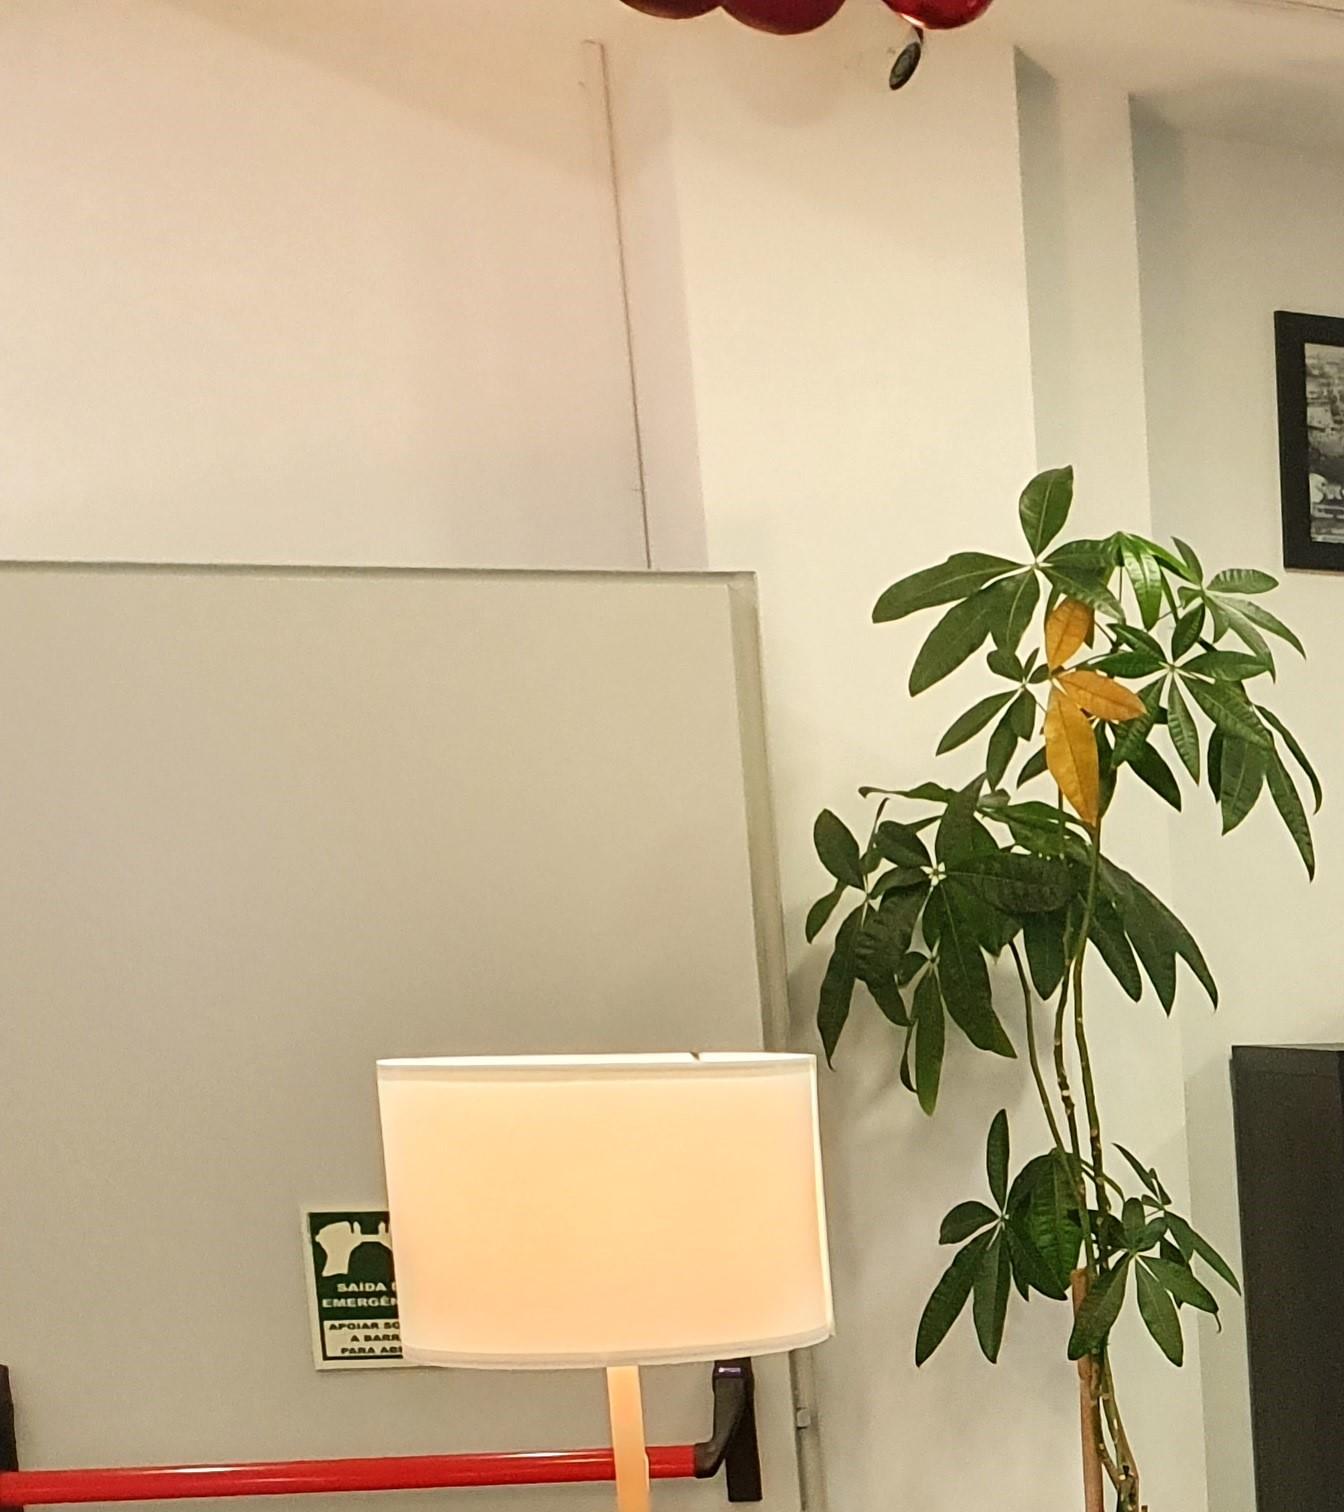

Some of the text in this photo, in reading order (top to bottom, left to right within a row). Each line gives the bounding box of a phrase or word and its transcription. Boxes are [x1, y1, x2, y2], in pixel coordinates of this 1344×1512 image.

[322, 1296, 397, 1308] EMERGÊN
[329, 1321, 400, 1330] APOIAR SO
[364, 1334, 401, 1342] BARR
